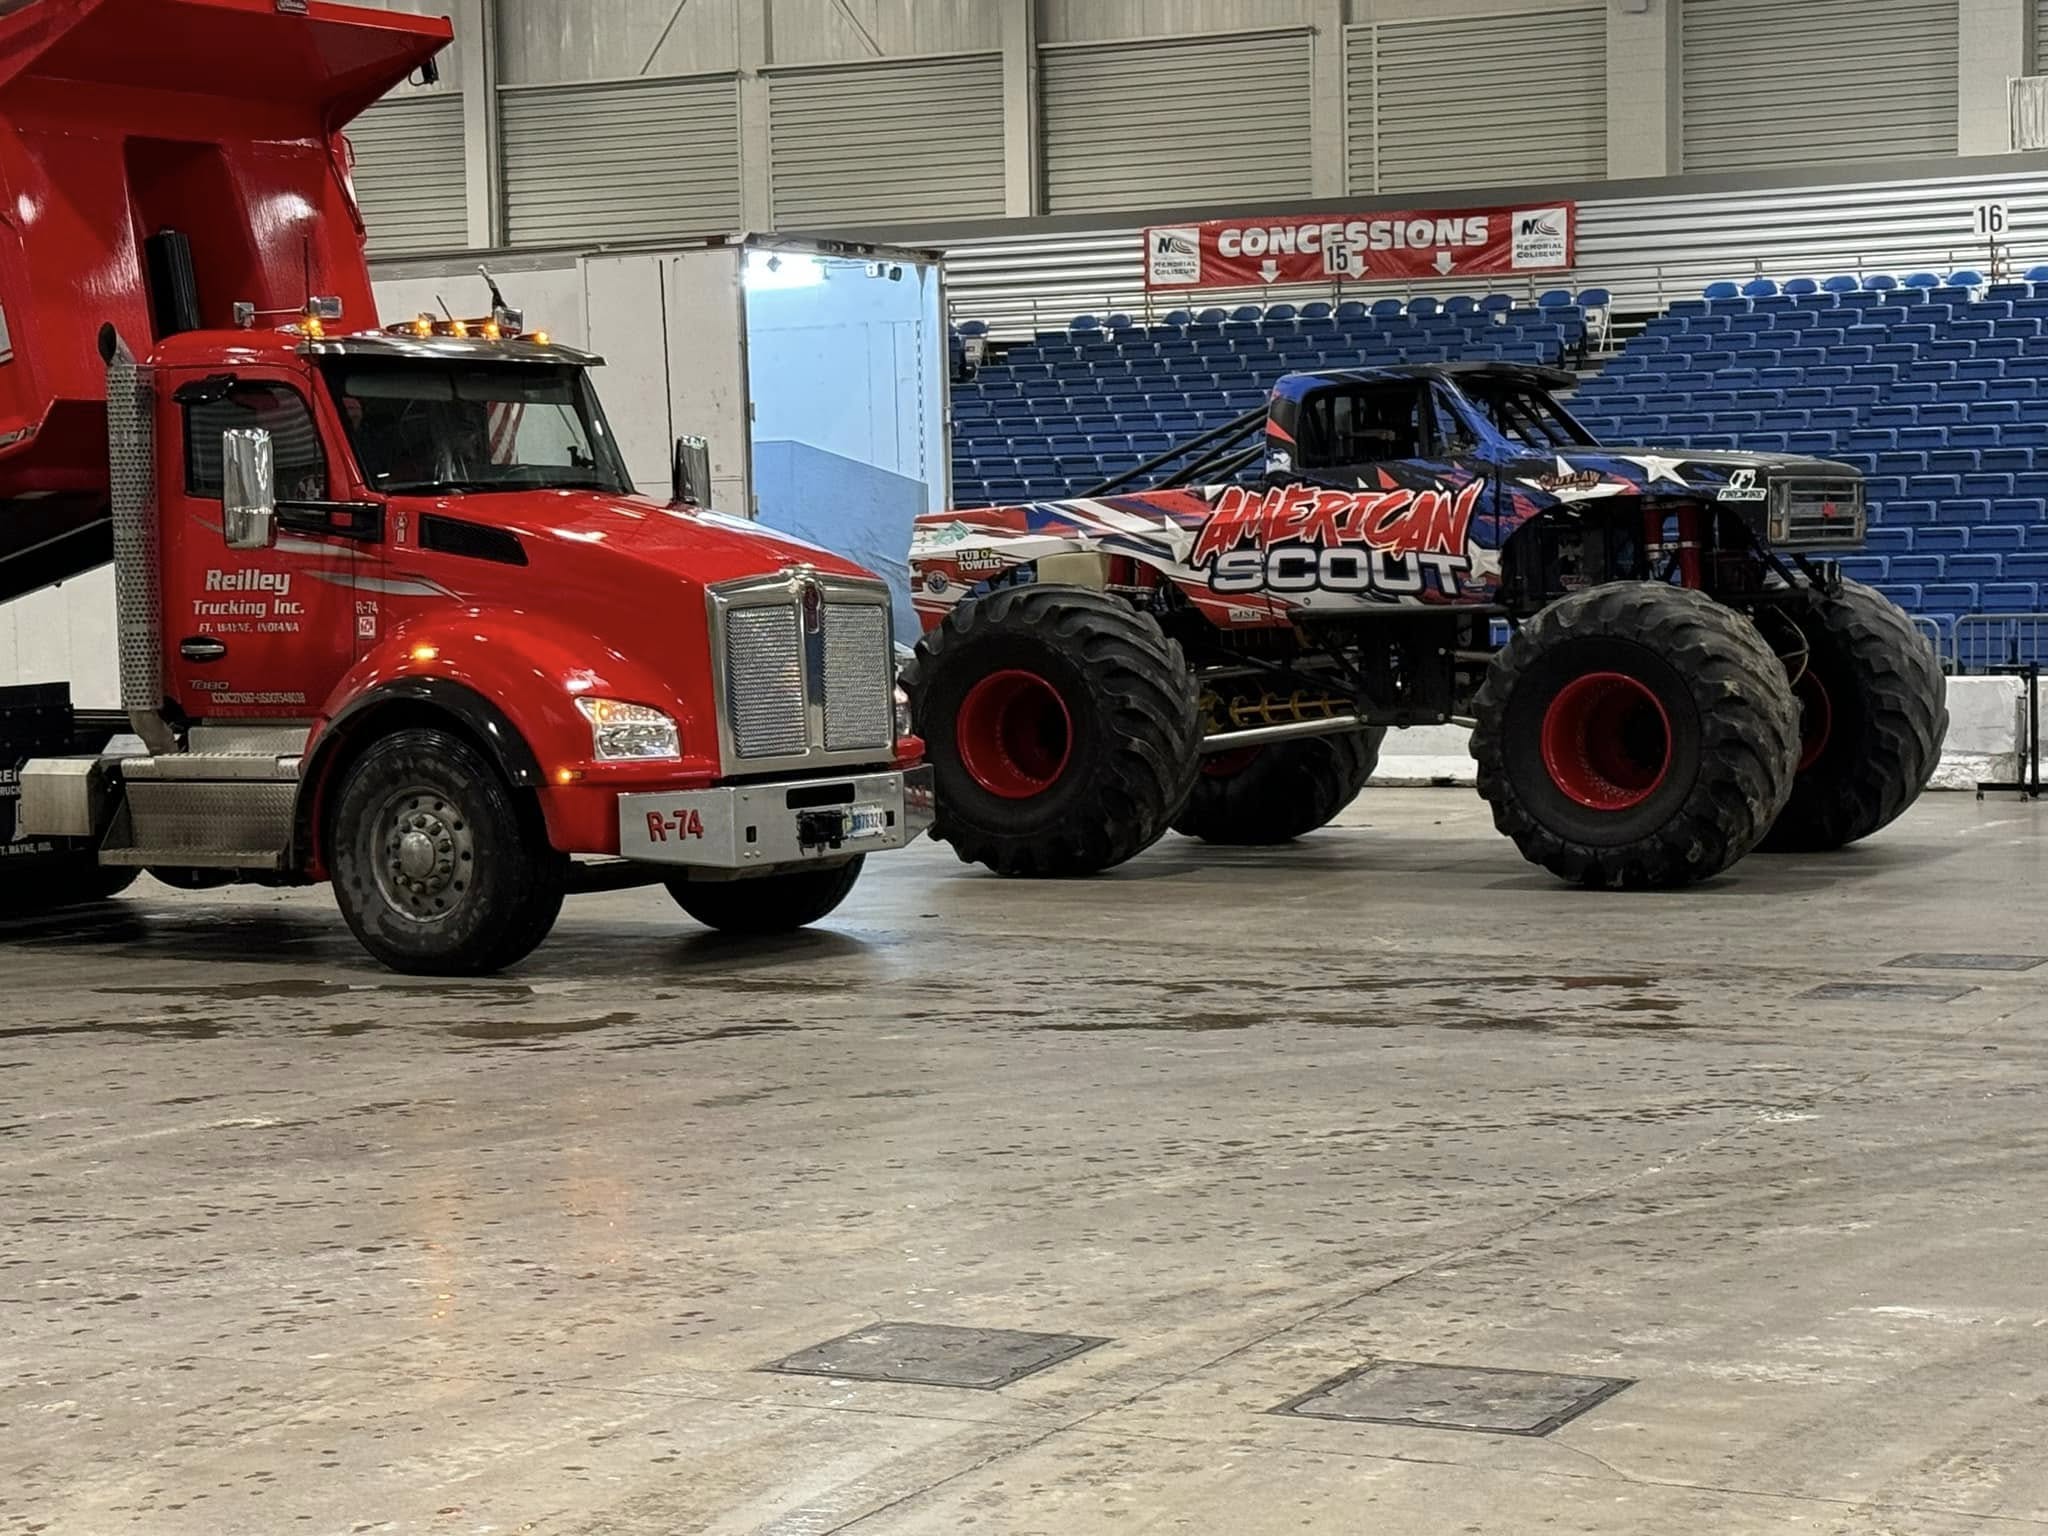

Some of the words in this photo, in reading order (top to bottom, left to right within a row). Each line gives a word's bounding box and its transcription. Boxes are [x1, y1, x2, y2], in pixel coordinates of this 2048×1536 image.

[1978, 205, 2002, 233] 16
[1217, 216, 1489, 259] CONCESSIONS
[1516, 243, 1563, 251] MEMORIAL
[1327, 245, 1348, 271] 15
[1193, 478, 1485, 566] AMERICAN
[958, 551, 980, 560] TUB
[959, 559, 1001, 570] TOWELS
[205, 569, 290, 595] Reilley
[1212, 547, 1468, 596] SCOUT
[193, 600, 267, 618] Trucking
[274, 599, 305, 615] Inc.
[356, 601, 378, 614] R-74
[199, 623, 213, 633] FT.
[257, 622, 300, 632] INDIANA
[646, 809, 703, 842] R-74
